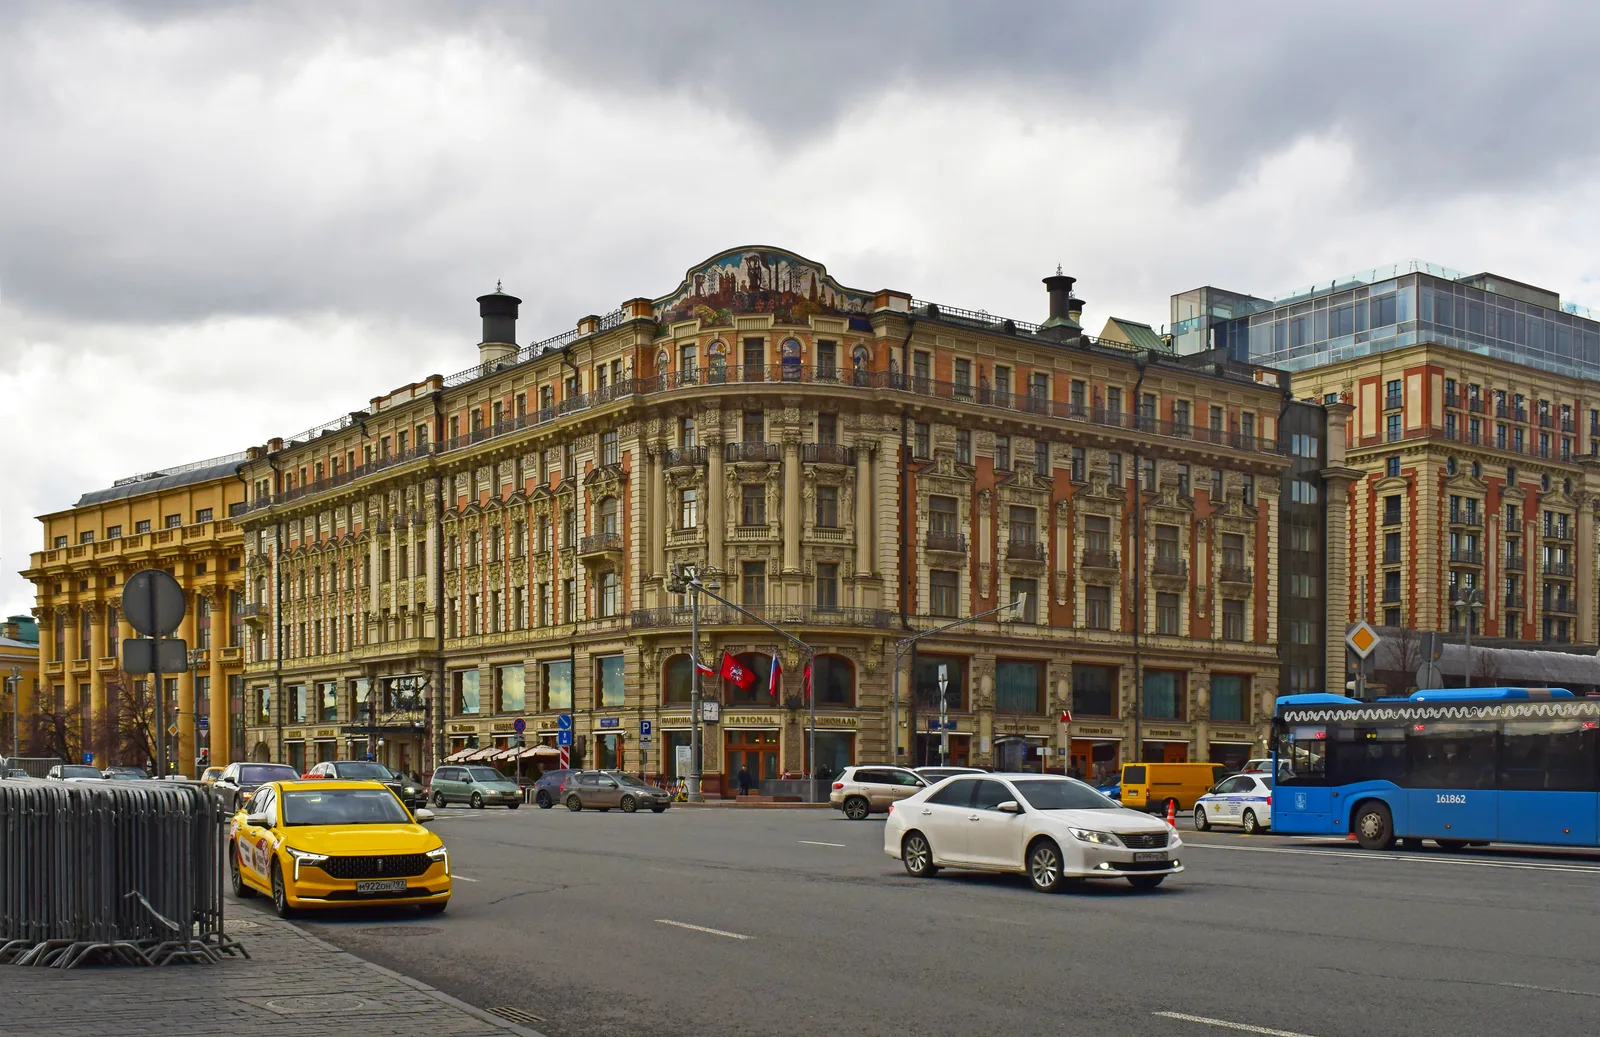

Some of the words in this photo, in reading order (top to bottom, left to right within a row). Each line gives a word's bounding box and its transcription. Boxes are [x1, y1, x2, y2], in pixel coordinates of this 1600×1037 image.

[728, 716, 775, 725] NATIONAL
[642, 722, 650, 733] P
[1436, 794, 1466, 804] 161862
